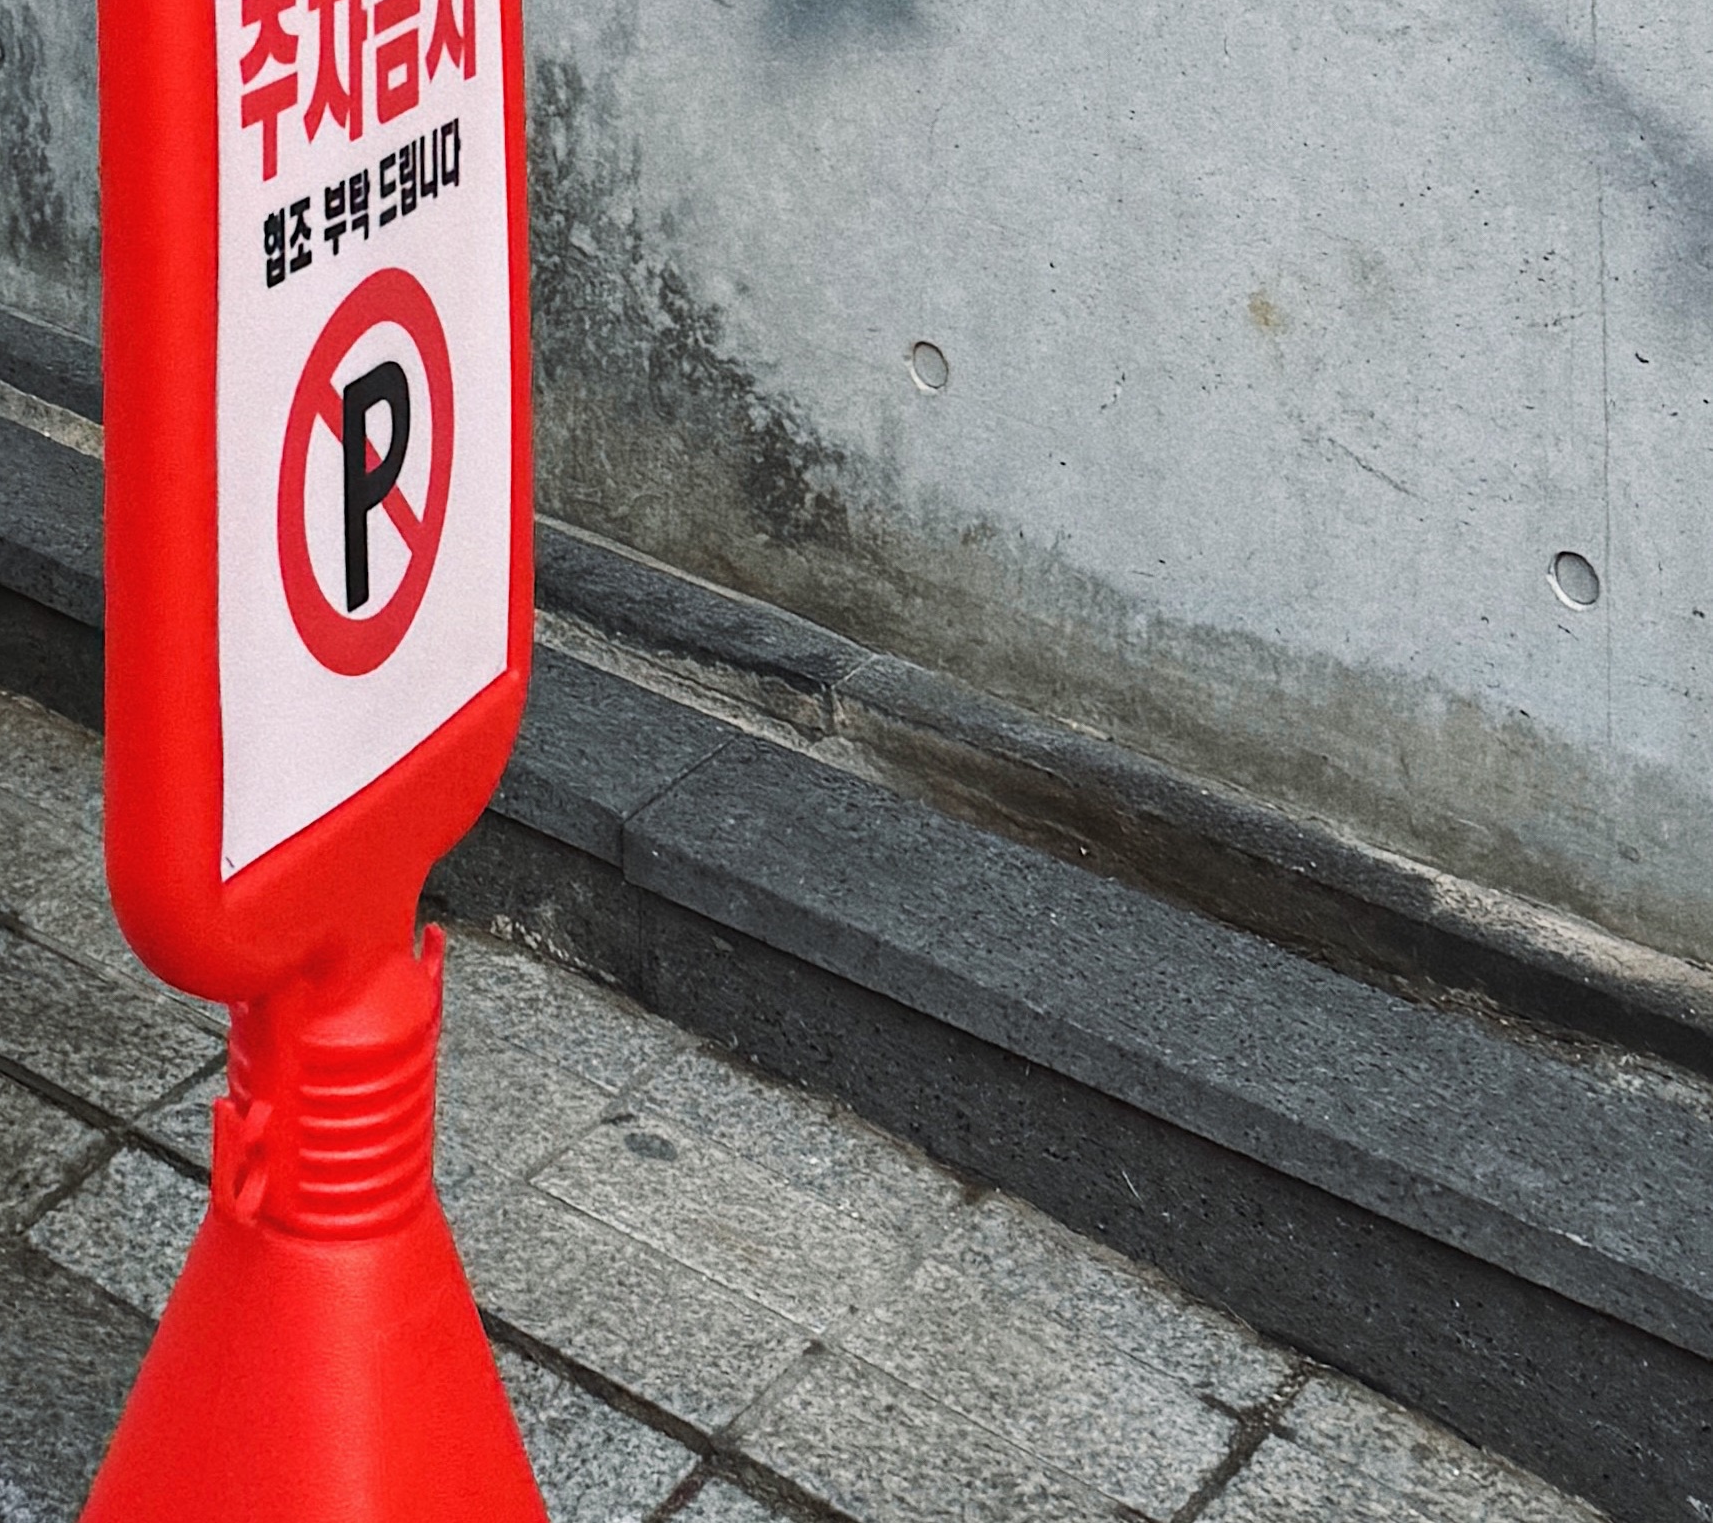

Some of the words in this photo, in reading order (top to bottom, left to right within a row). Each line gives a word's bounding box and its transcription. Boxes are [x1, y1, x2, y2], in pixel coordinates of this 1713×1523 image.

[263, 196, 312, 289] 협조
[324, 168, 371, 256] 부탁
[379, 117, 462, 228] 드립니다
[341, 360, 411, 613] P
